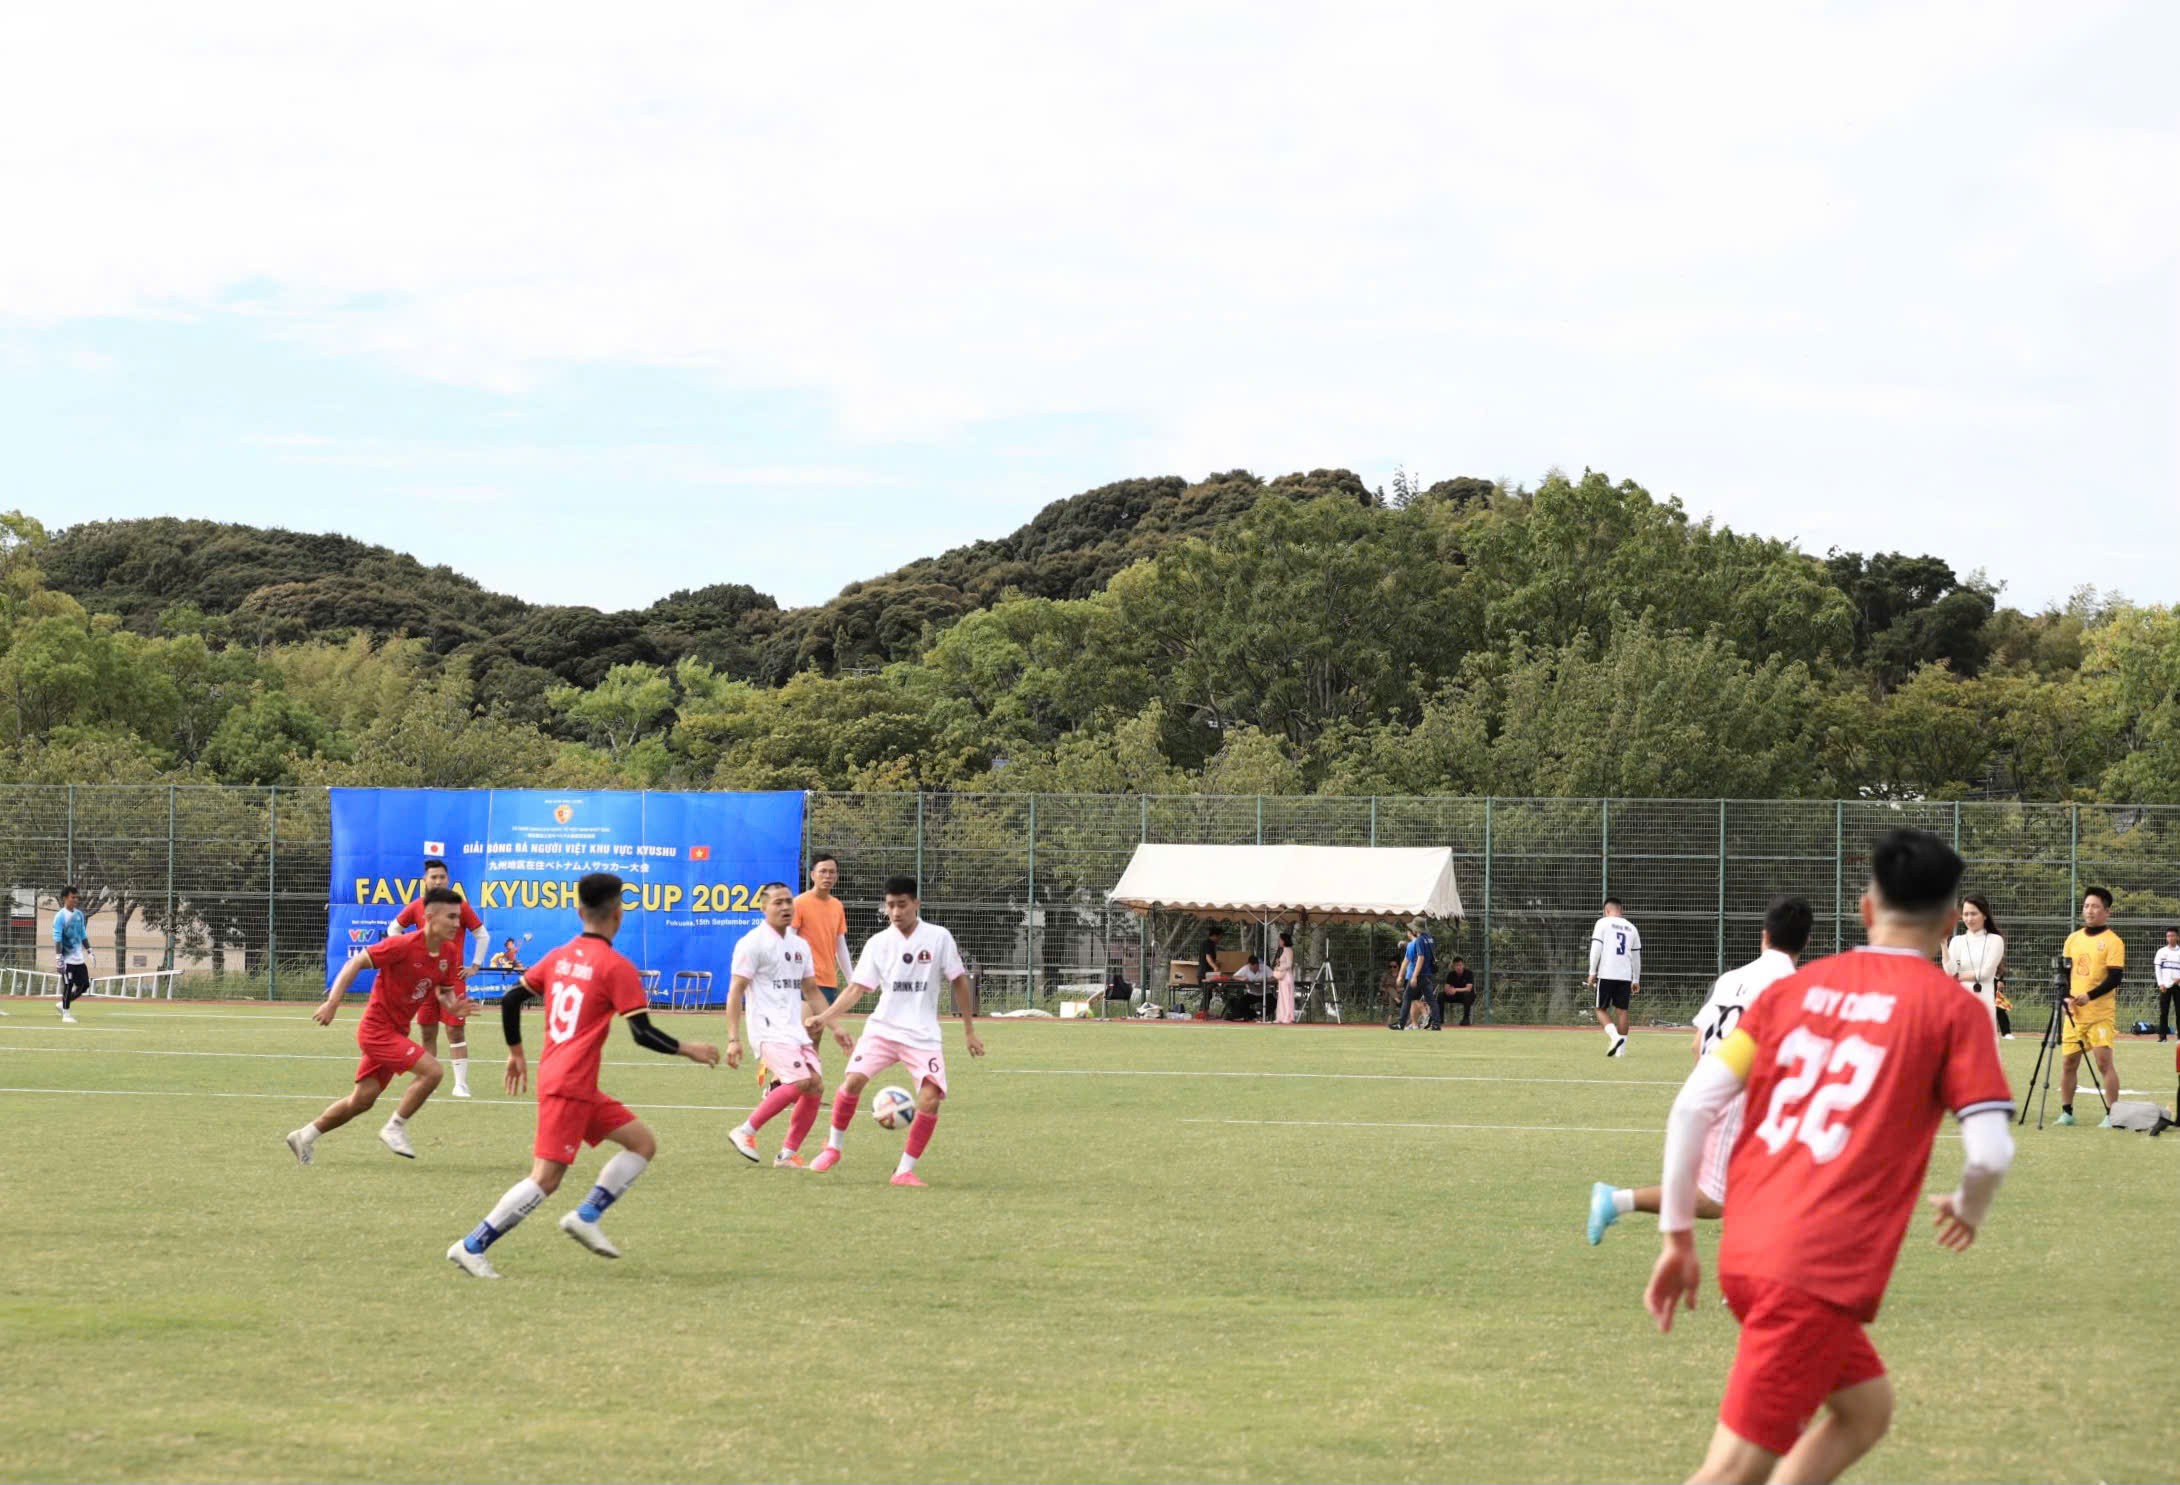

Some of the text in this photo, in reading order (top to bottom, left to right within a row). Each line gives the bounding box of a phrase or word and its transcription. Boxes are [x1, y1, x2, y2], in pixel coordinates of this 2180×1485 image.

[565, 842, 586, 856] VIỆT
[590, 844, 610, 854] KHU
[613, 845, 633, 857] VỰC
[637, 845, 676, 857] KYUSHU
[355, 877, 468, 905] FAVIA
[480, 880, 580, 909] KYUSH
[621, 883, 683, 912] CUP
[712, 918, 749, 926] September
[348, 928, 375, 943] VTV
[1616, 932, 1626, 955] 3
[893, 980, 913, 992] DRINK
[549, 981, 585, 1045] 19
[928, 1057, 939, 1074] 6
[1754, 1023, 1888, 1166] 22
